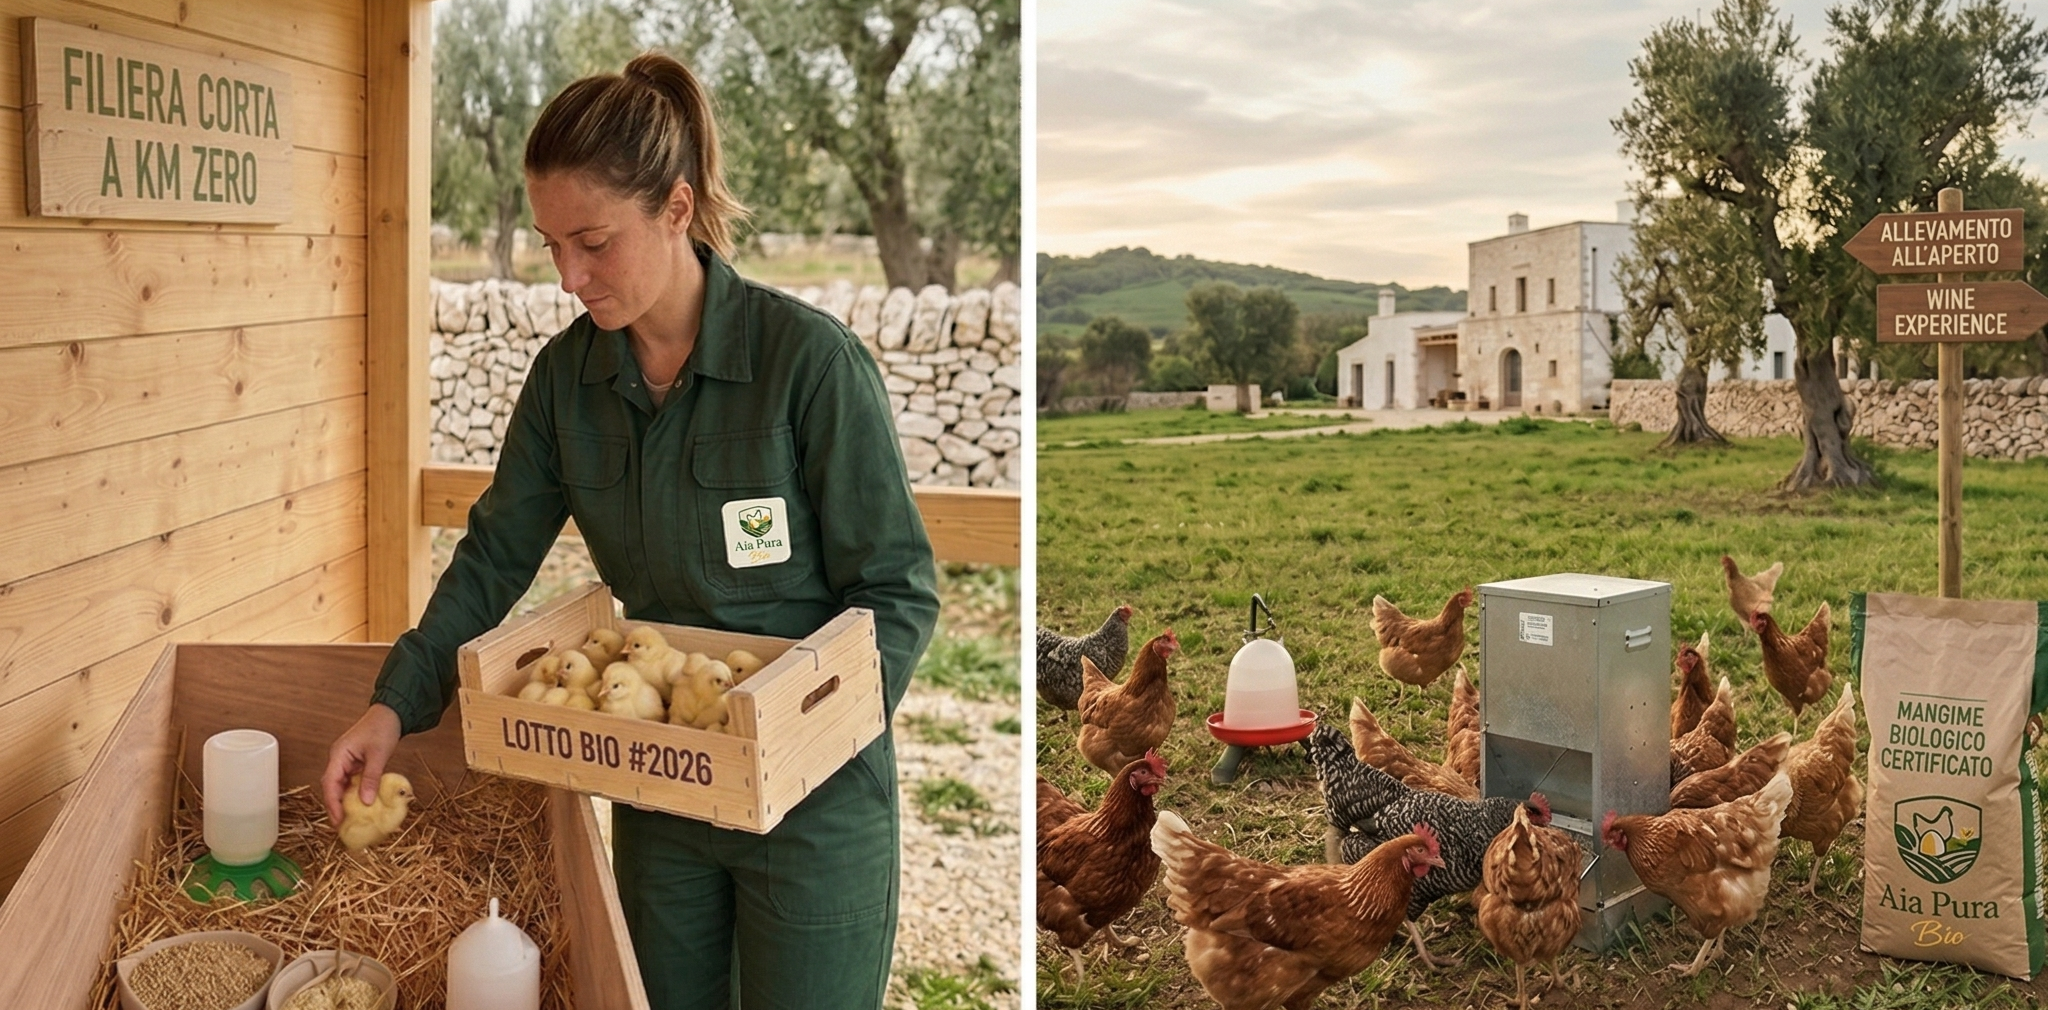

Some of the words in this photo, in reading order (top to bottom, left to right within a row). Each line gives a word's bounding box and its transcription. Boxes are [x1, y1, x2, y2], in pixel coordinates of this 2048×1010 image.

[64, 47, 187, 126] FILIERA
[198, 73, 280, 139] CORTA
[100, 136, 123, 198] A
[135, 139, 181, 200] KM
[192, 145, 257, 206] ZERO
[1880, 217, 2012, 243] ALLEVAMENTO
[1891, 243, 1999, 267] ALL'APERTO
[1926, 288, 1976, 310] WINE
[1895, 313, 2008, 336] EXPERIENCE
[735, 541, 754, 551] Aia
[756, 538, 783, 548] Pura
[1897, 700, 1985, 727] MANGIME
[1889, 723, 1986, 751] BIOLOGICO
[502, 717, 573, 759] LOTTO
[579, 730, 620, 768] BIO
[628, 741, 713, 786] #2026
[1881, 747, 1993, 778] CERTIFICATO
[1879, 883, 1924, 915] Aia
[1931, 890, 2000, 919] Pura
[1910, 919, 1973, 947] Bio
